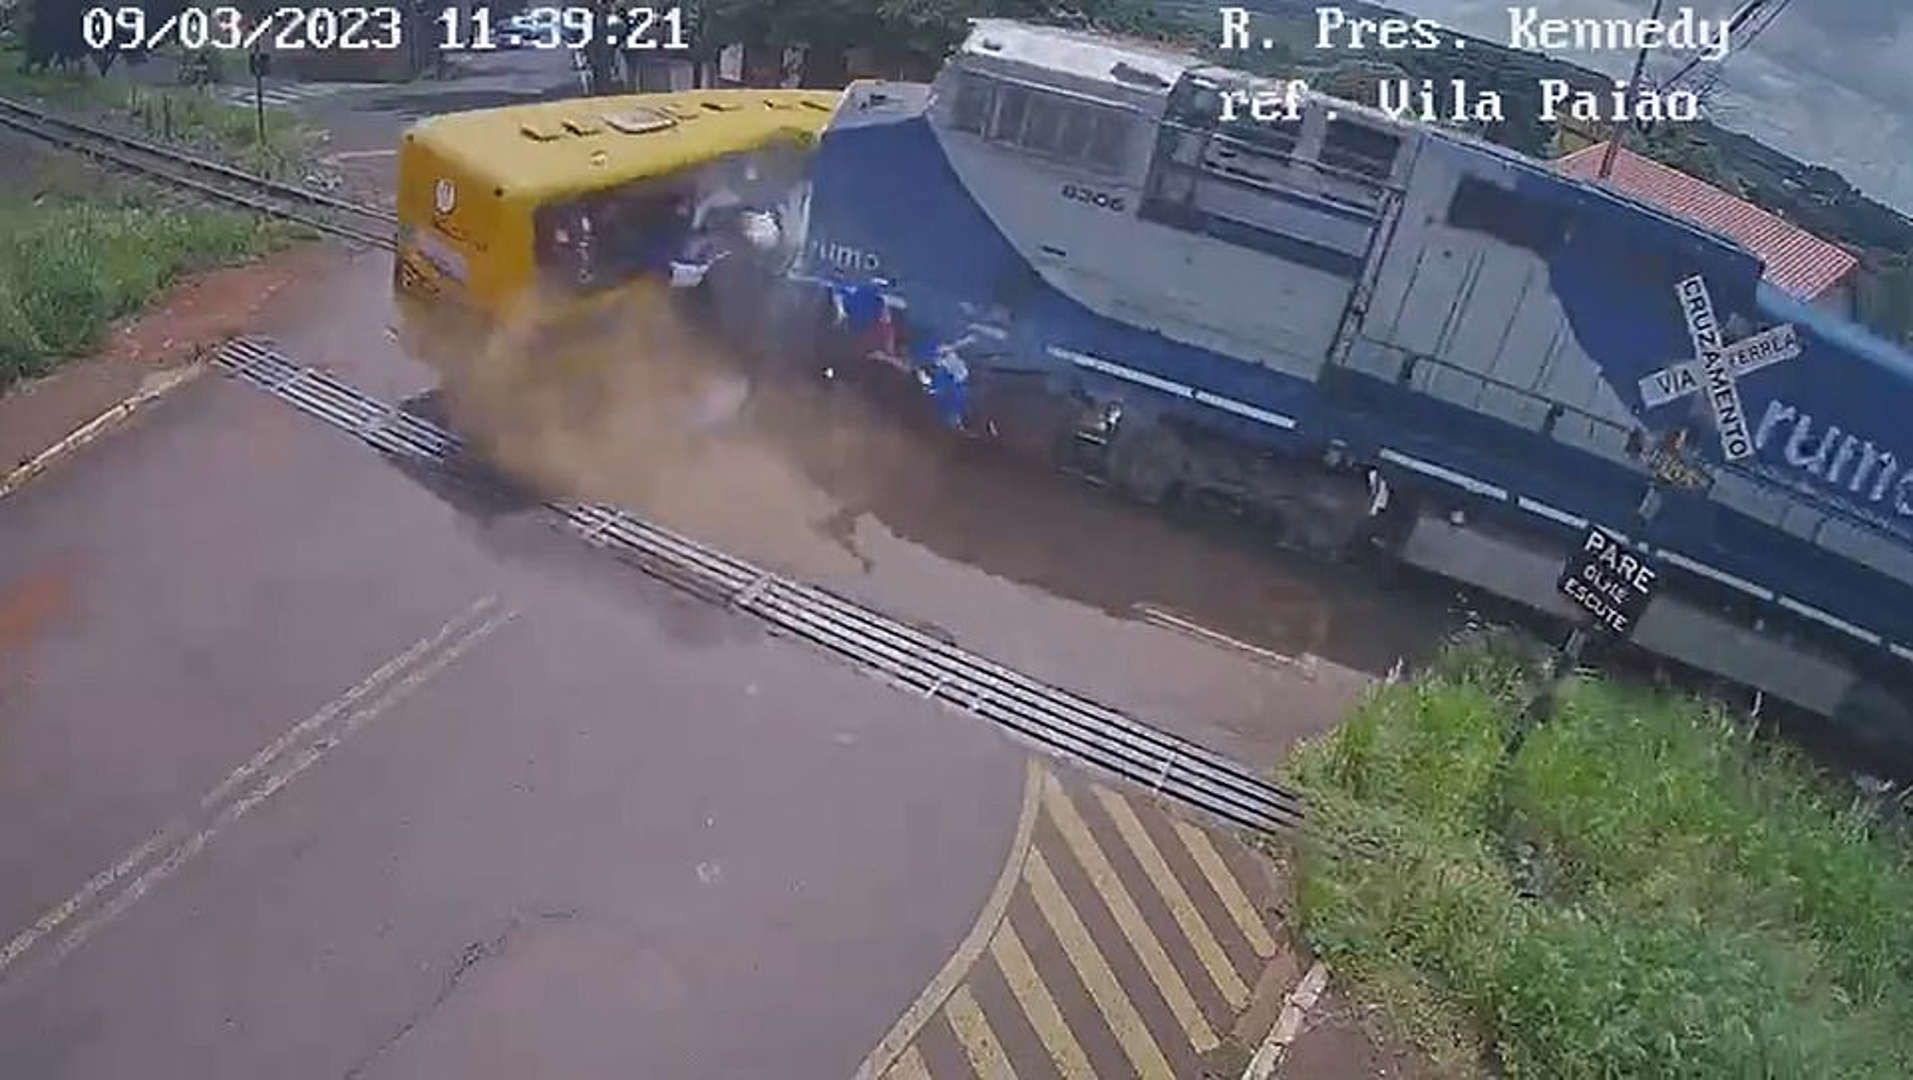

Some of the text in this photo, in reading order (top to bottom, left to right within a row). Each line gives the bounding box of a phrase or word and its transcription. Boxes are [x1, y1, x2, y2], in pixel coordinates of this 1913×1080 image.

[1657, 369, 1697, 395] VIA
[1683, 280, 1748, 457] CRUZAMENTO
[1584, 531, 1656, 594] PARE
[1563, 577, 1629, 632] ESCUTE
